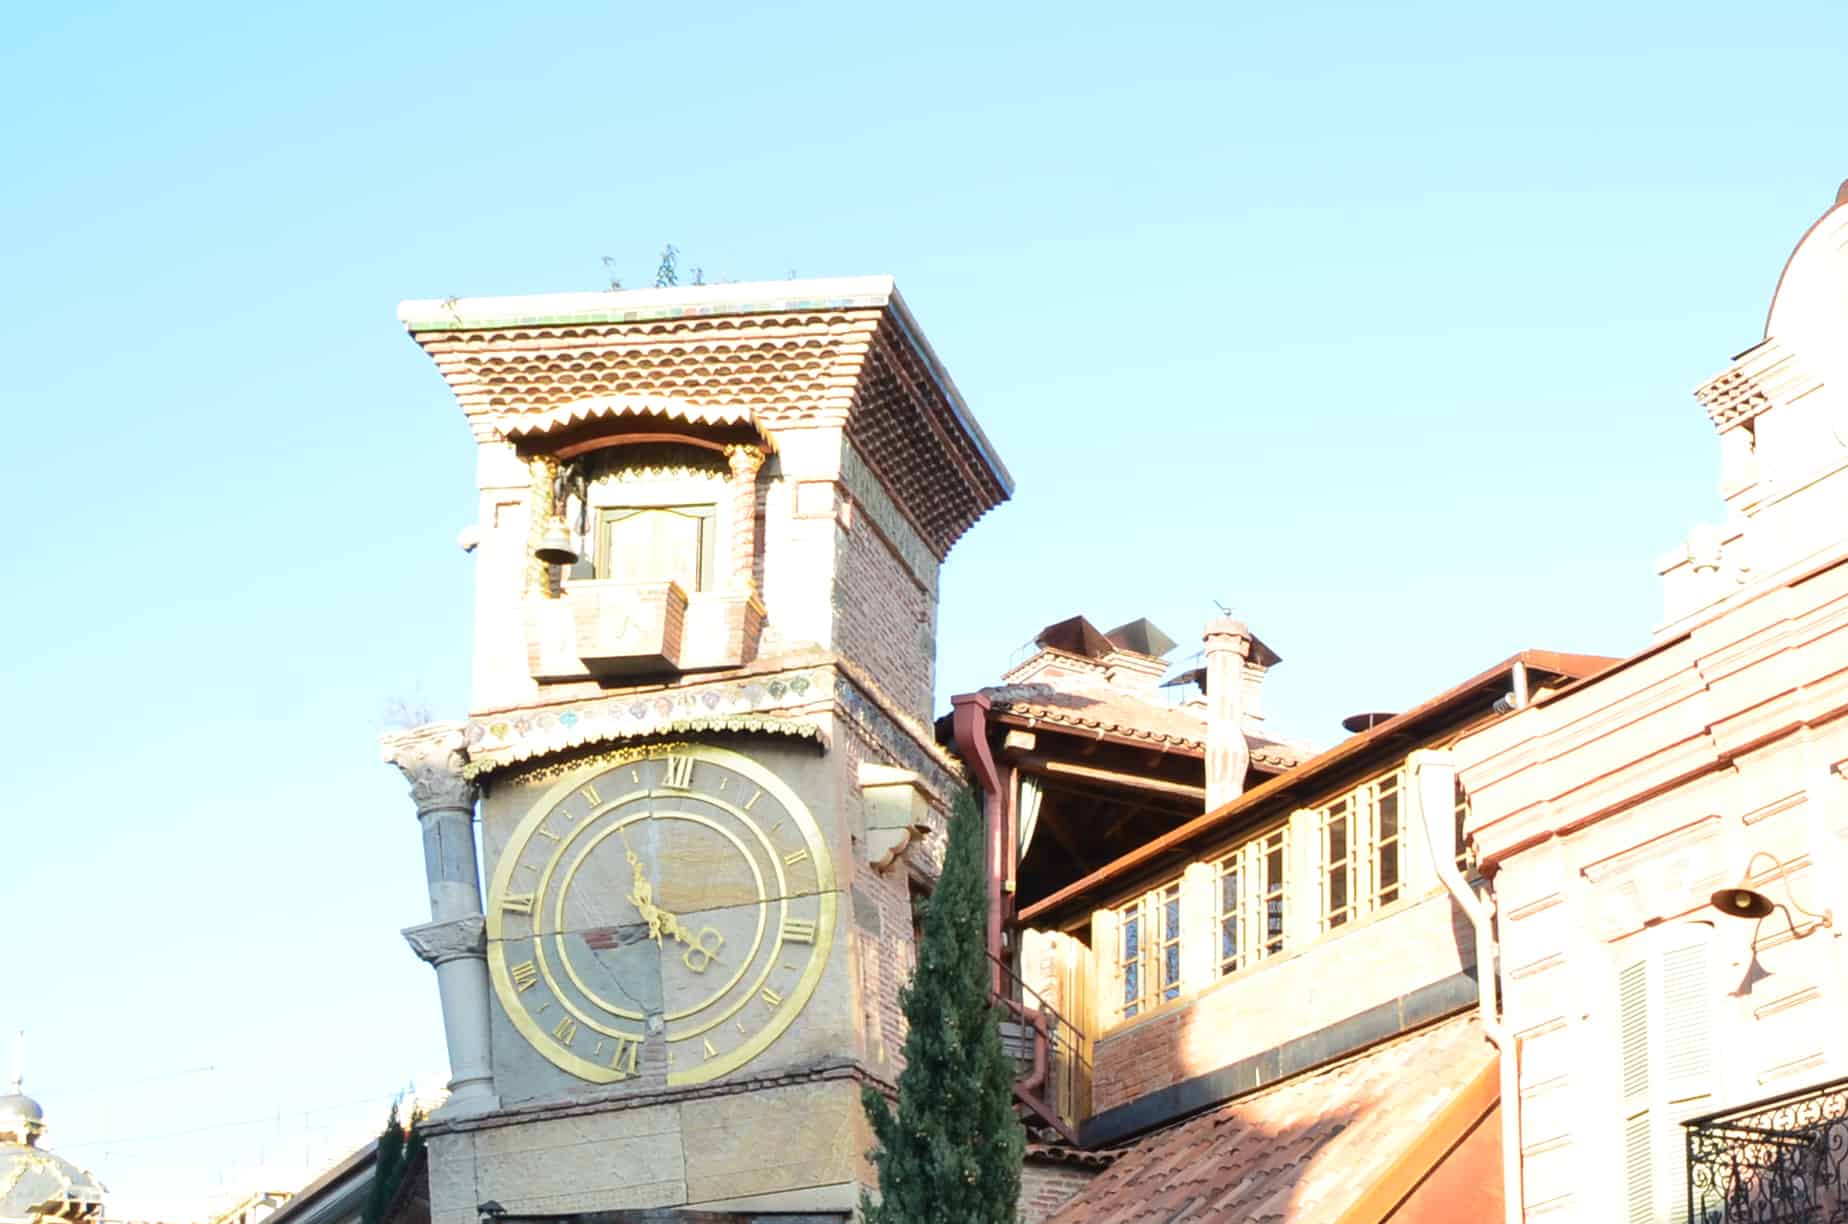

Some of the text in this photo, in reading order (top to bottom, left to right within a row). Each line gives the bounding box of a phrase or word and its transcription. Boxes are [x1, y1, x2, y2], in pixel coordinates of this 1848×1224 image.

[663, 756, 694, 788] XII
[783, 849, 808, 865] II
[782, 918, 816, 944] III
[512, 960, 537, 992] VIII
